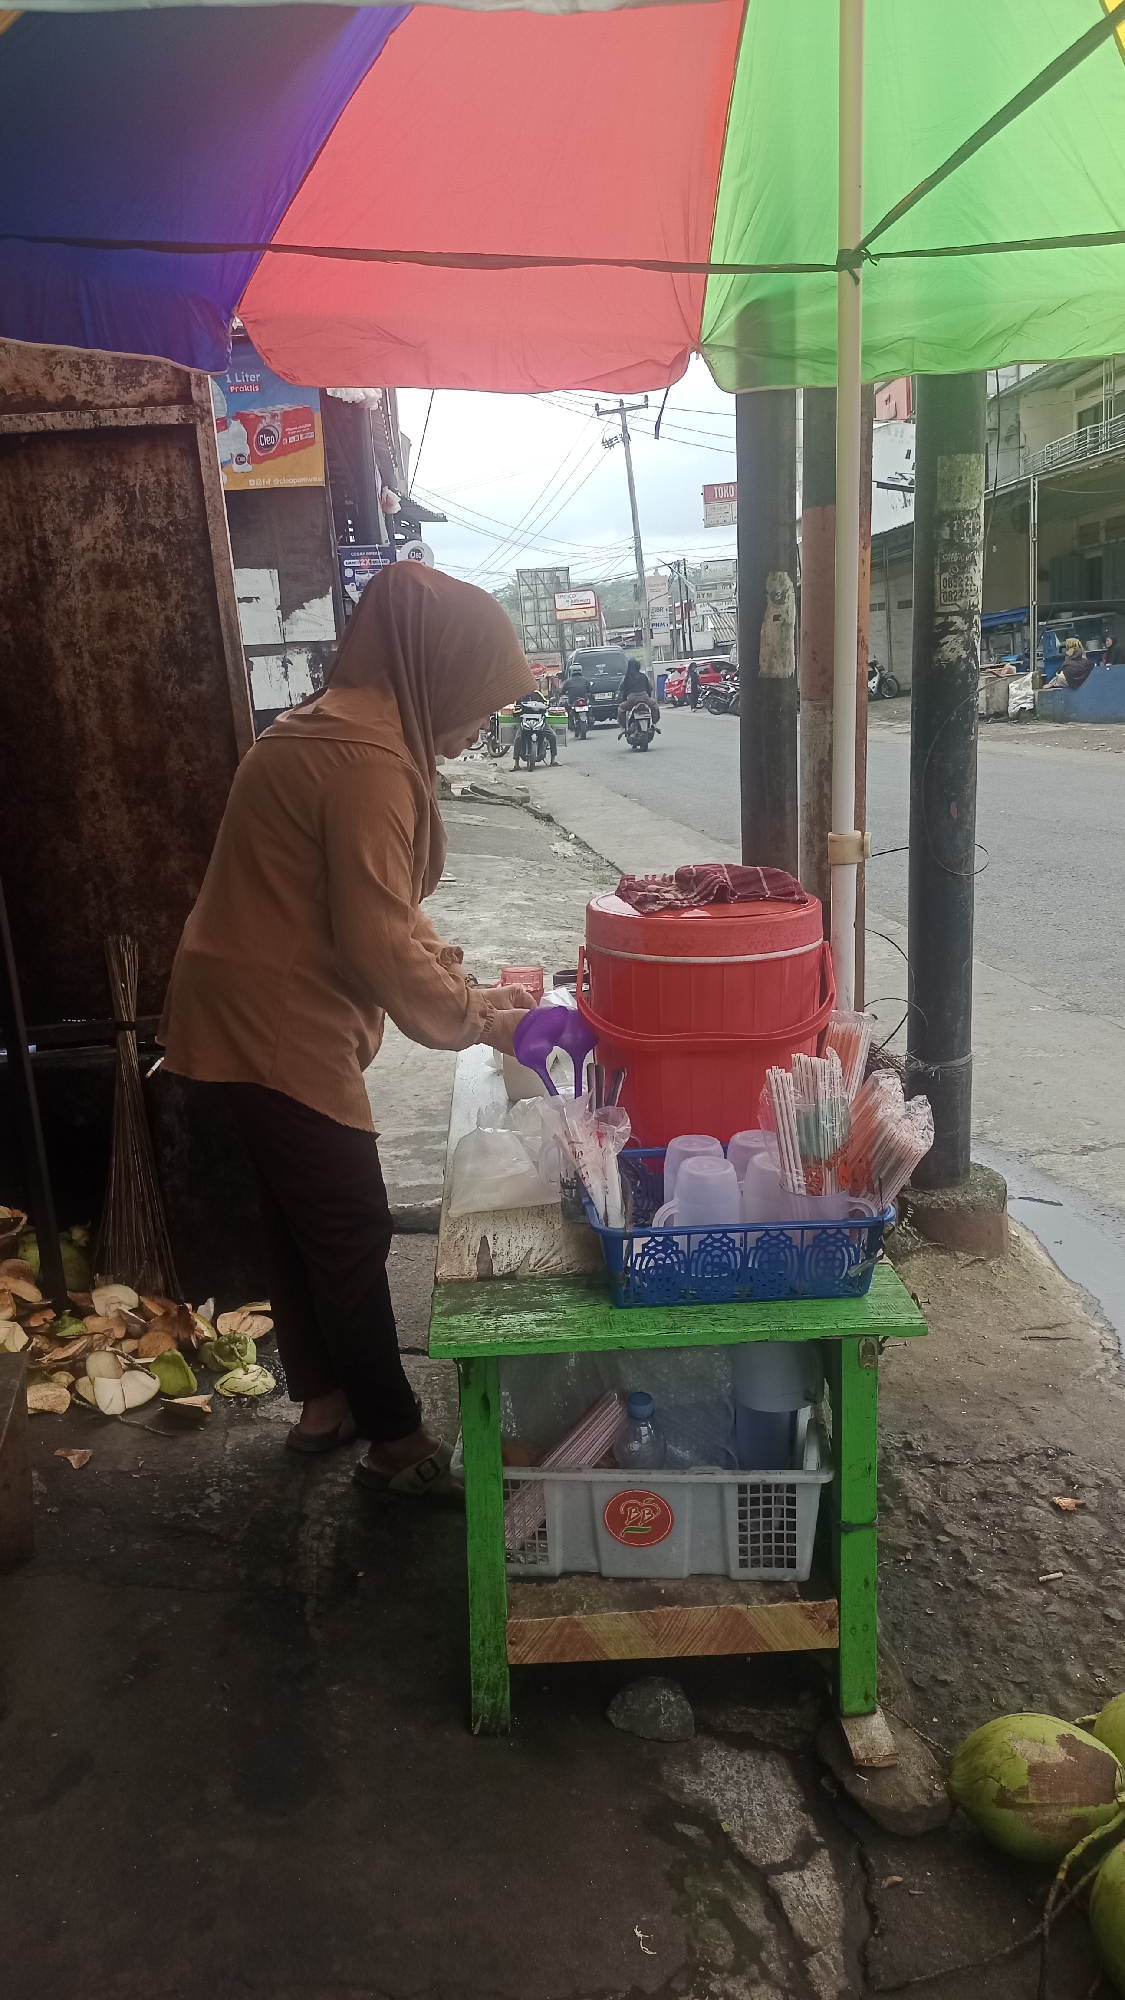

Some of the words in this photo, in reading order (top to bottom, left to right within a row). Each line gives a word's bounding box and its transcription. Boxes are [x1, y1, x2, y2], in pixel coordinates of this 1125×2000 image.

[226, 375, 231, 383] 1
[235, 372, 260, 383] Liter
[260, 434, 275, 446] Cleo
[713, 485, 735, 499] TOKO
[360, 558, 371, 566] 2X
